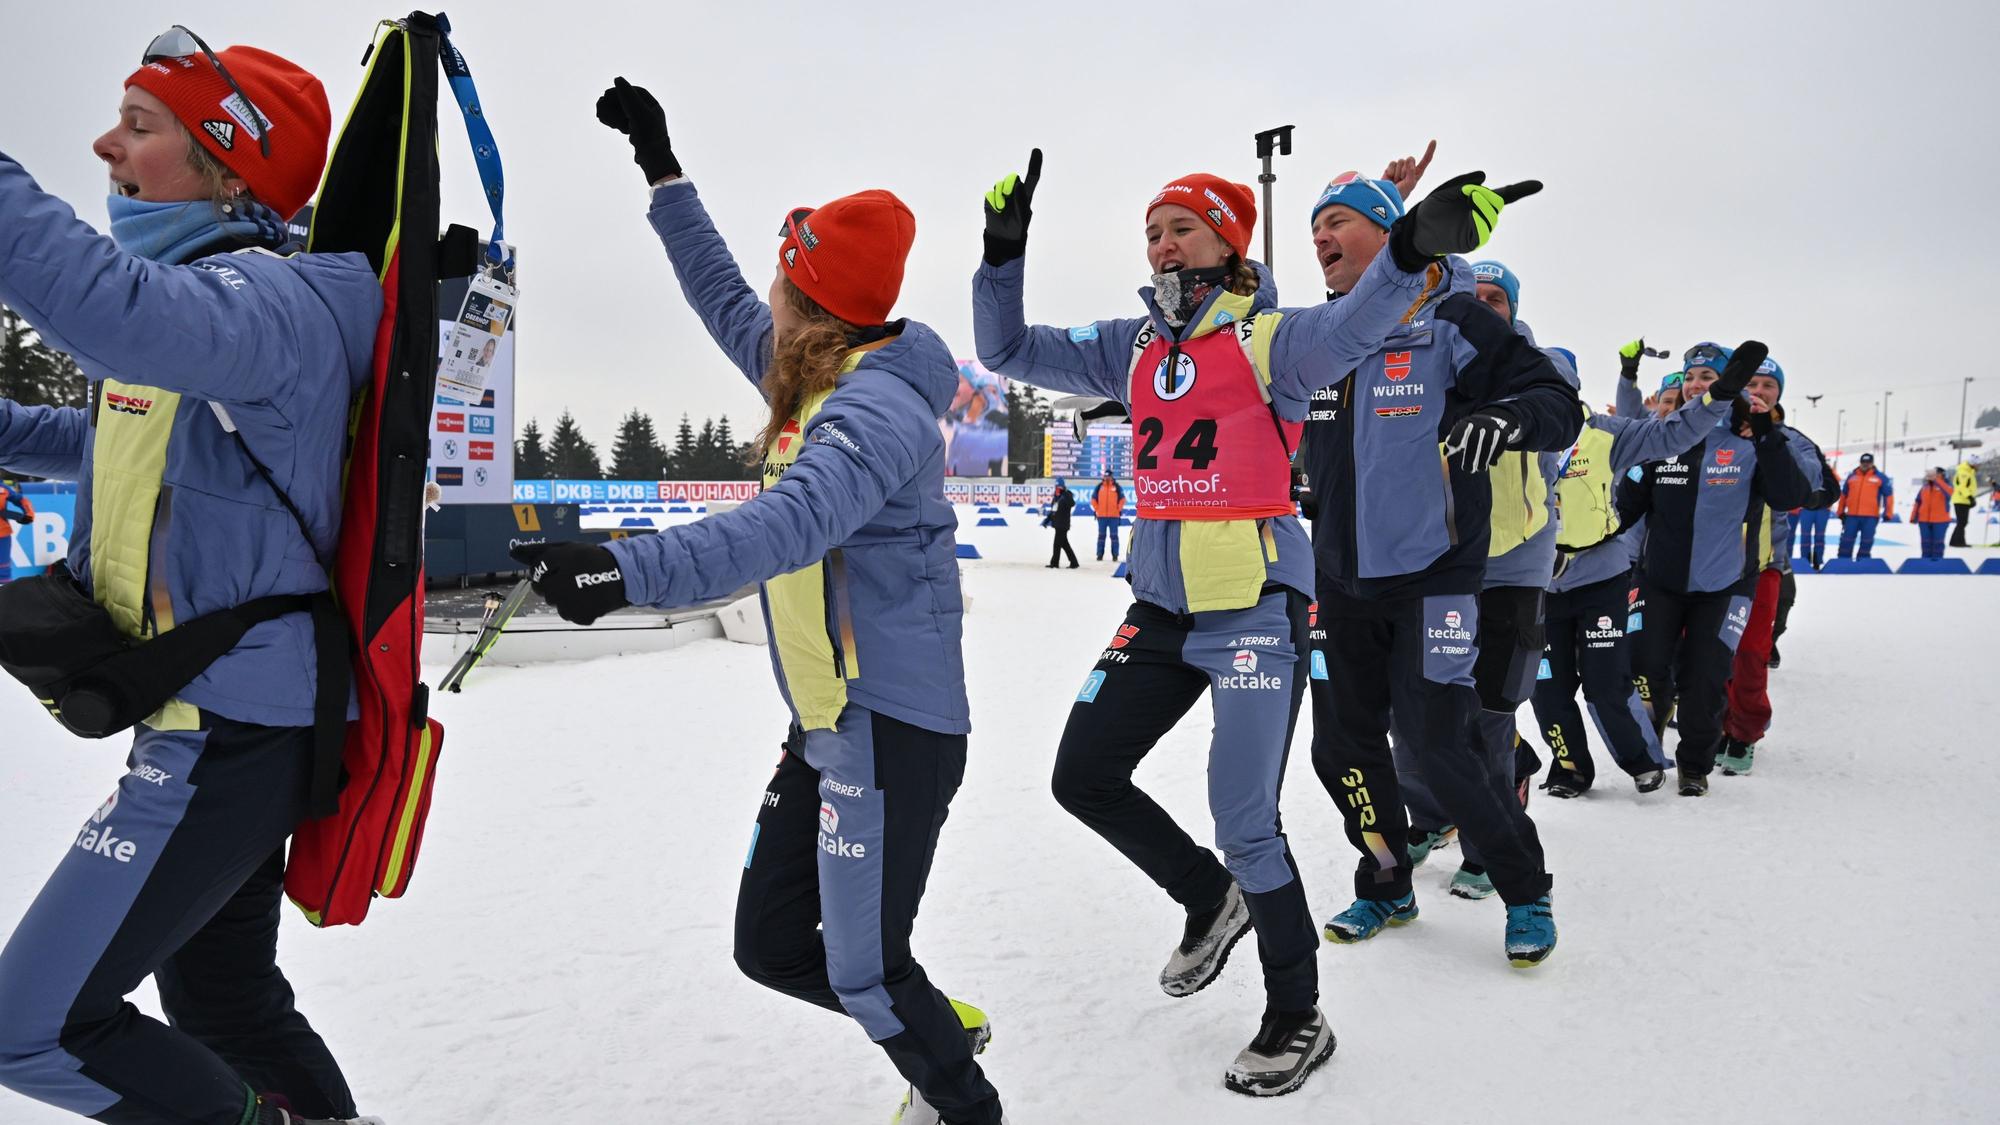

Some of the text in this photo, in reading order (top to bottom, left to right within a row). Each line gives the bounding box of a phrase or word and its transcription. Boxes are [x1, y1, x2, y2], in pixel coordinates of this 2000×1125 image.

[203, 122, 231, 149] adidas
[1163, 185, 1192, 194] MANN
[289, 224, 308, 236] IBU
[465, 313, 489, 325] OBERHOF
[1373, 384, 1424, 397] WÜRTH
[473, 417, 490, 428] DKB
[1137, 417, 1219, 470] 24
[1571, 458, 1589, 466] RTH
[974, 485, 1000, 494] LIQUI
[1007, 485, 1031, 494] LIQUI
[1038, 486, 1054, 495] LIQ
[1138, 474, 1227, 495] Oberhof.
[513, 484, 536, 499] KB
[556, 484, 592, 499] DKB
[608, 484, 645, 499] DKB
[660, 485, 760, 500] BAUHAUS
[975, 494, 1000, 503] MOLY
[1007, 495, 1031, 504] MOLY
[522, 506, 529, 525] 1
[8, 512, 69, 568] KB
[1428, 627, 1471, 640] tectake
[1586, 628, 1623, 639] tectake
[1240, 636, 1280, 647] TERREX
[1442, 646, 1470, 655] TERREX
[1548, 724, 1569, 758] GER
[826, 779, 864, 798] TERREX
[1341, 767, 1377, 829] GER
[75, 822, 137, 863] take
